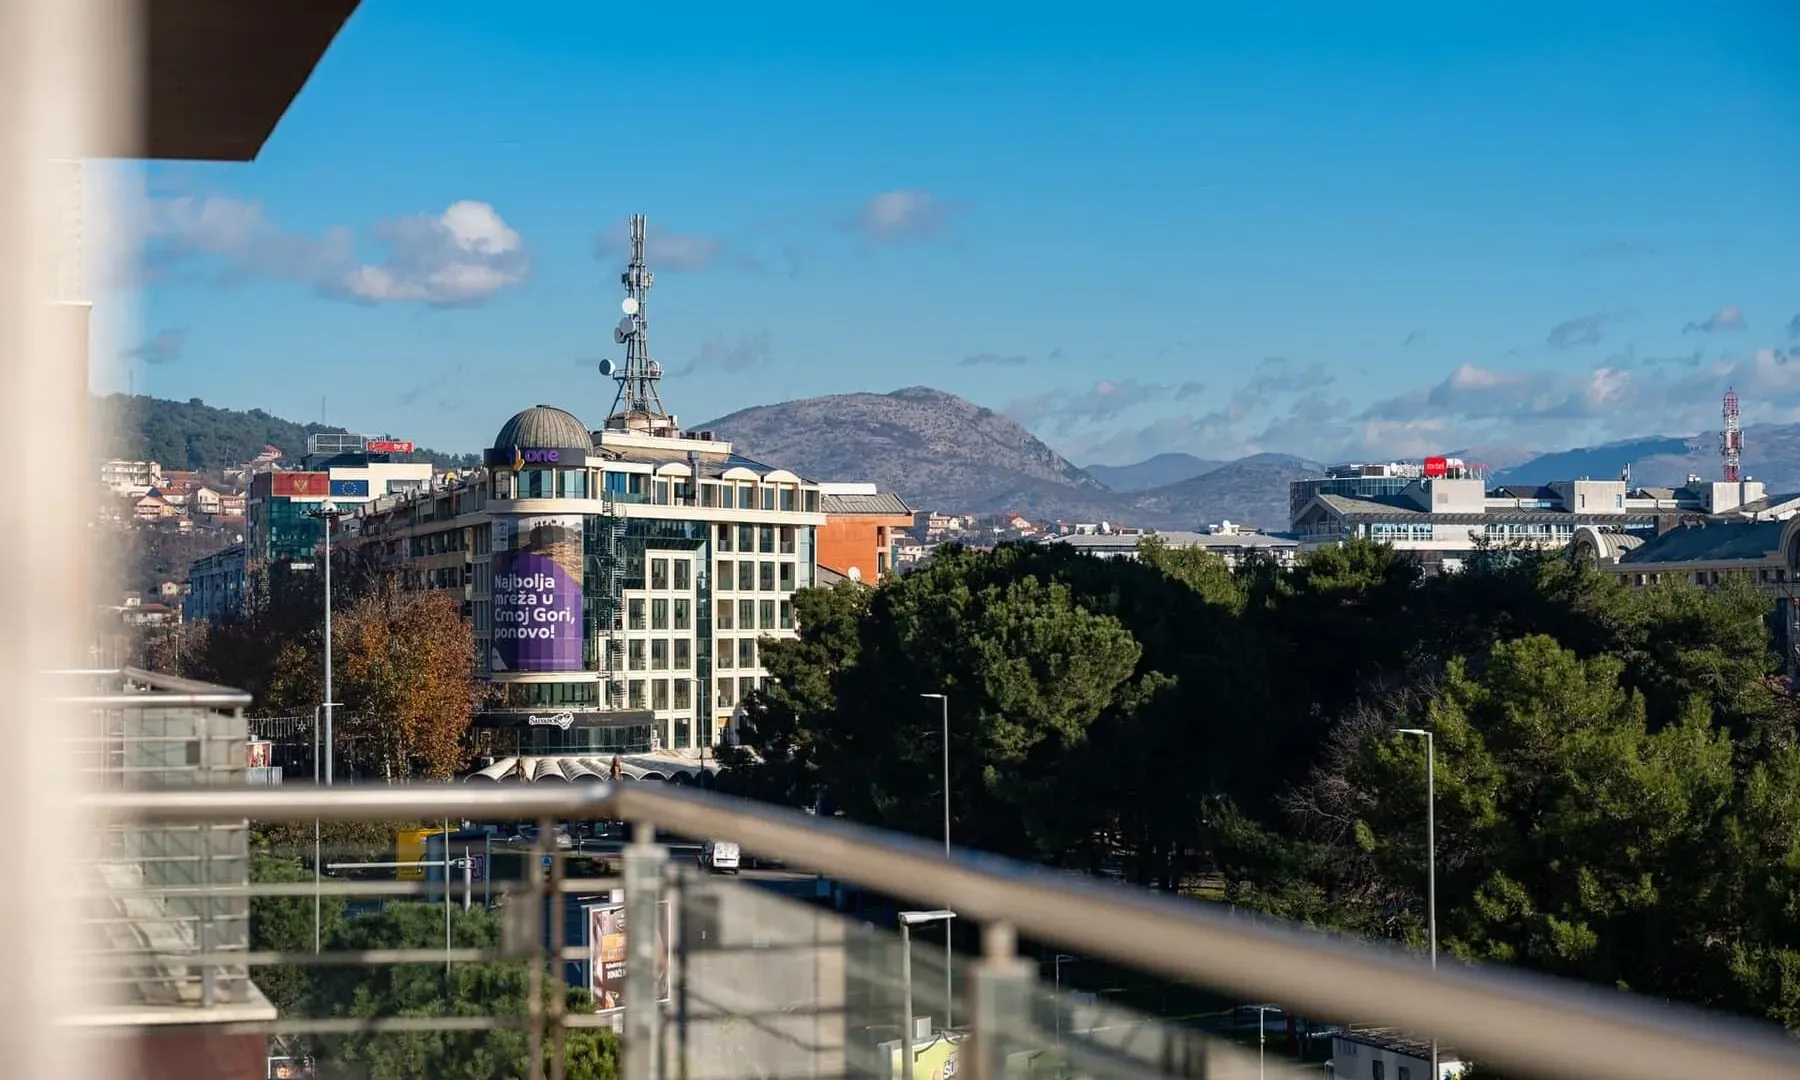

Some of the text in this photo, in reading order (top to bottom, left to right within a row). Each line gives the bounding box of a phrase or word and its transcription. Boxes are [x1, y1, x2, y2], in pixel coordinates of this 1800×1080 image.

[525, 450, 559, 462] one
[494, 573, 555, 592] Najbolja
[494, 590, 553, 605] mreža u
[494, 607, 575, 625] Crnoj Gori,
[494, 624, 555, 641] ponovo!
